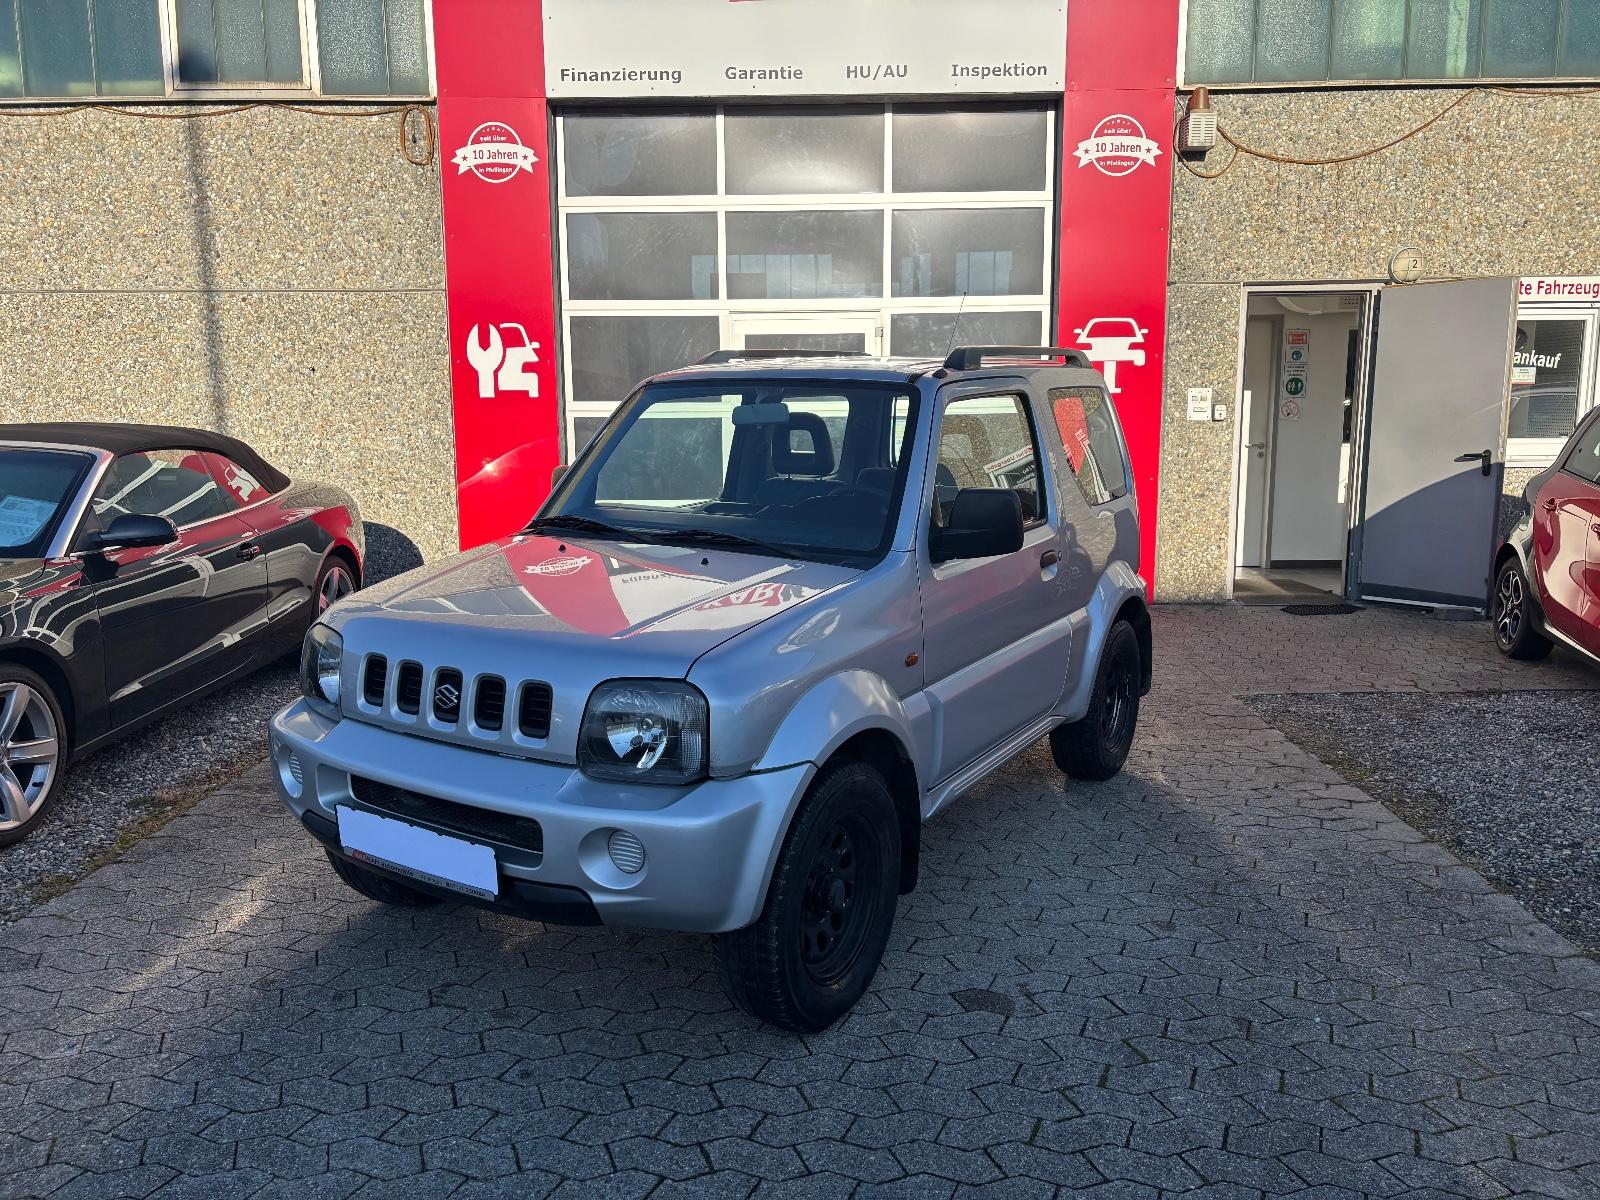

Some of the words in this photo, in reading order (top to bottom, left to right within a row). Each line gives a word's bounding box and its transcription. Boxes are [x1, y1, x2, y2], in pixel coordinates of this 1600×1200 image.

[560, 68, 682, 83] Finanzierung
[725, 66, 803, 80] Garantie
[846, 65, 908, 80] HU/AU
[951, 63, 1048, 79] Inspektion
[1095, 143, 1106, 153] 10
[1109, 142, 1141, 153] Jahren
[473, 150, 484, 160] 10
[487, 149, 519, 160] Jahren
[1412, 259, 1418, 269] 2
[1537, 280, 1600, 298] Fahrzeug
